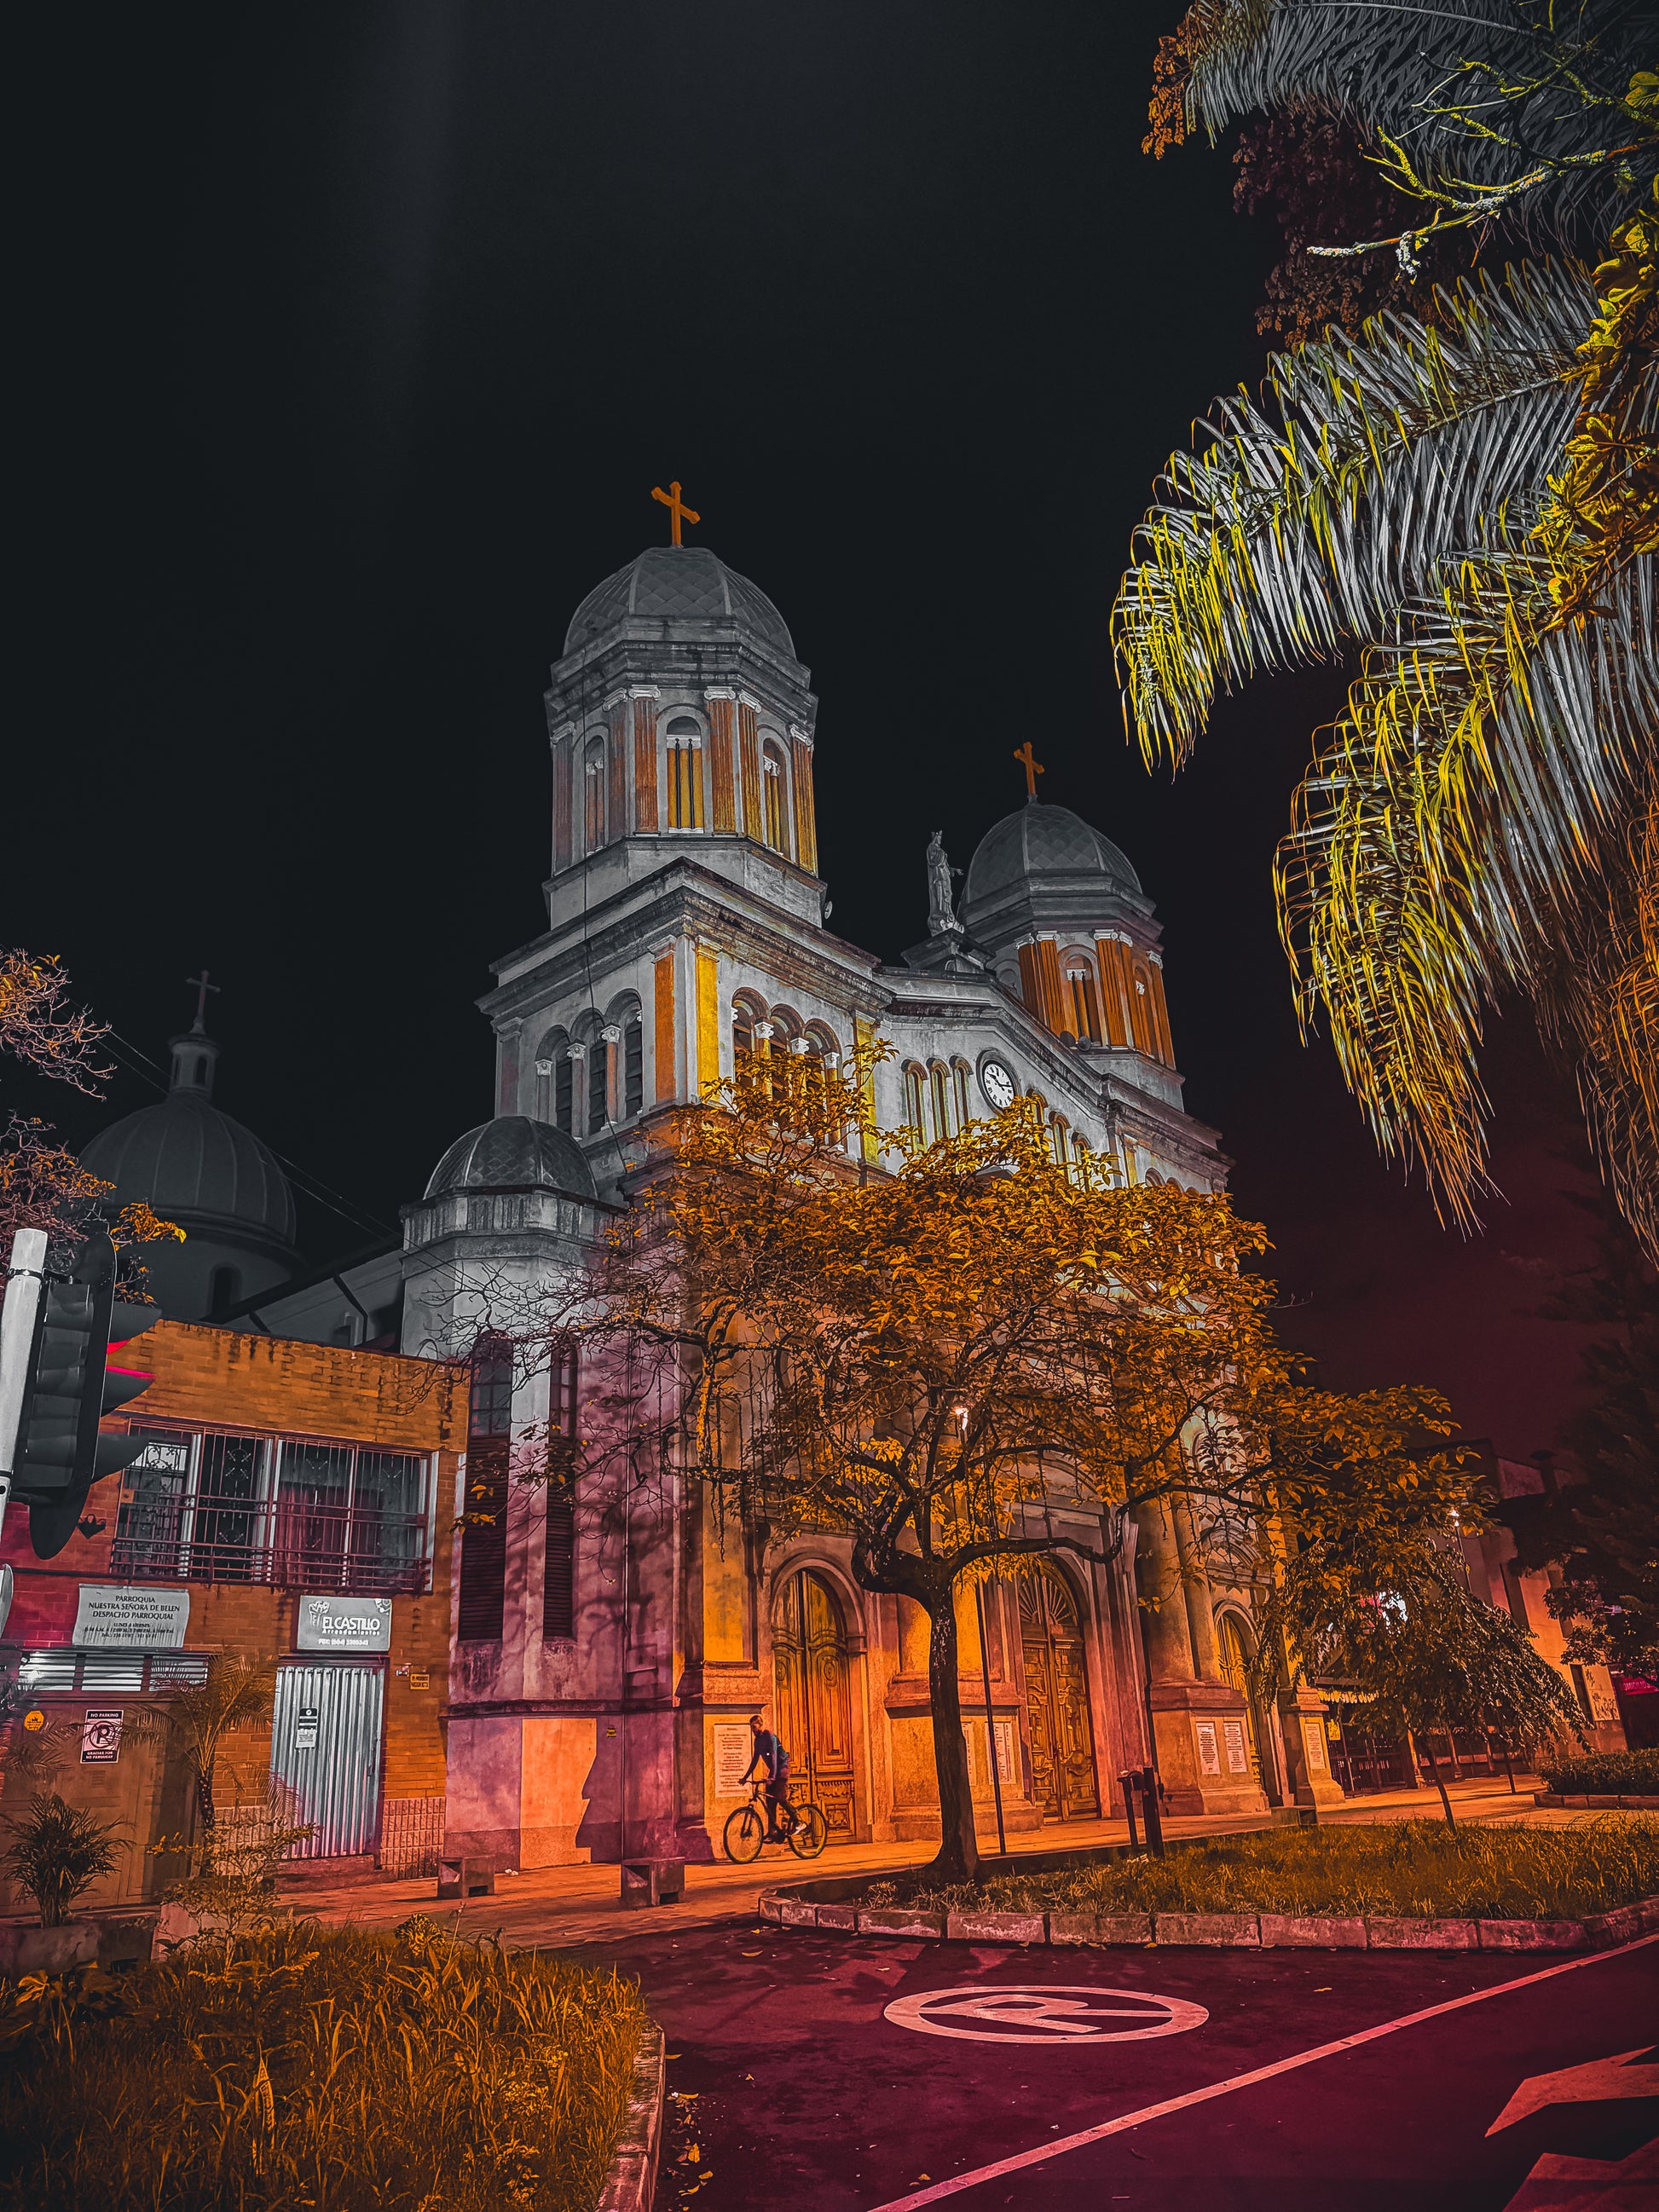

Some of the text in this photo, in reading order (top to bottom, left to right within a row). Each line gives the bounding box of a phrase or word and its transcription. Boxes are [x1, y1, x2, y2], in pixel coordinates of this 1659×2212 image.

[115, 1595, 156, 1603] PARROQUIA
[88, 1602, 120, 1610] NUESTRA
[121, 1603, 148, 1611] SEÑORA
[92, 1610, 130, 1619] DESPACHO
[322, 1616, 381, 1631] EL CASTILLO
